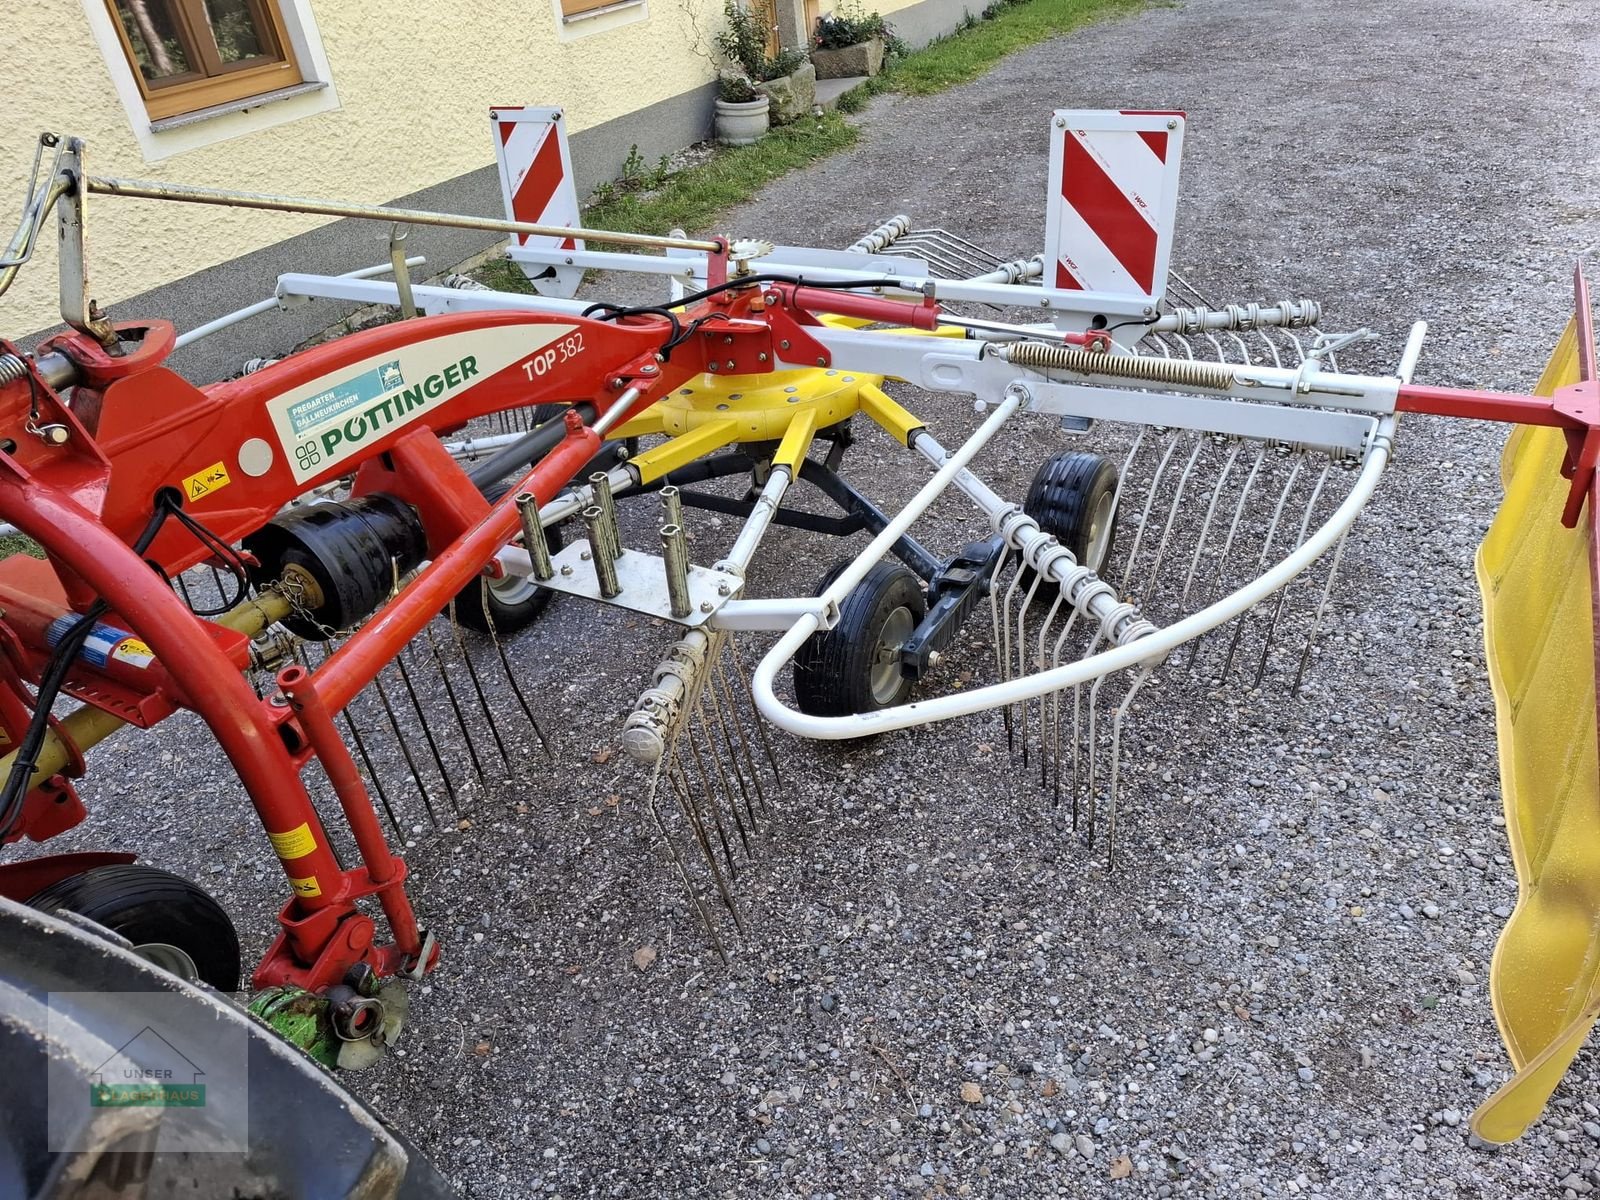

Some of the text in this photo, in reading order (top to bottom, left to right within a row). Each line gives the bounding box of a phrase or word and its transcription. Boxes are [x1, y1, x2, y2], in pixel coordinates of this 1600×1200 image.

[522, 333, 585, 381] TOP 382
[292, 391, 335, 416] PREGARTEN
[296, 393, 359, 428] GALLNEUKIRCHEN
[321, 355, 479, 457] PÖTTINGER
